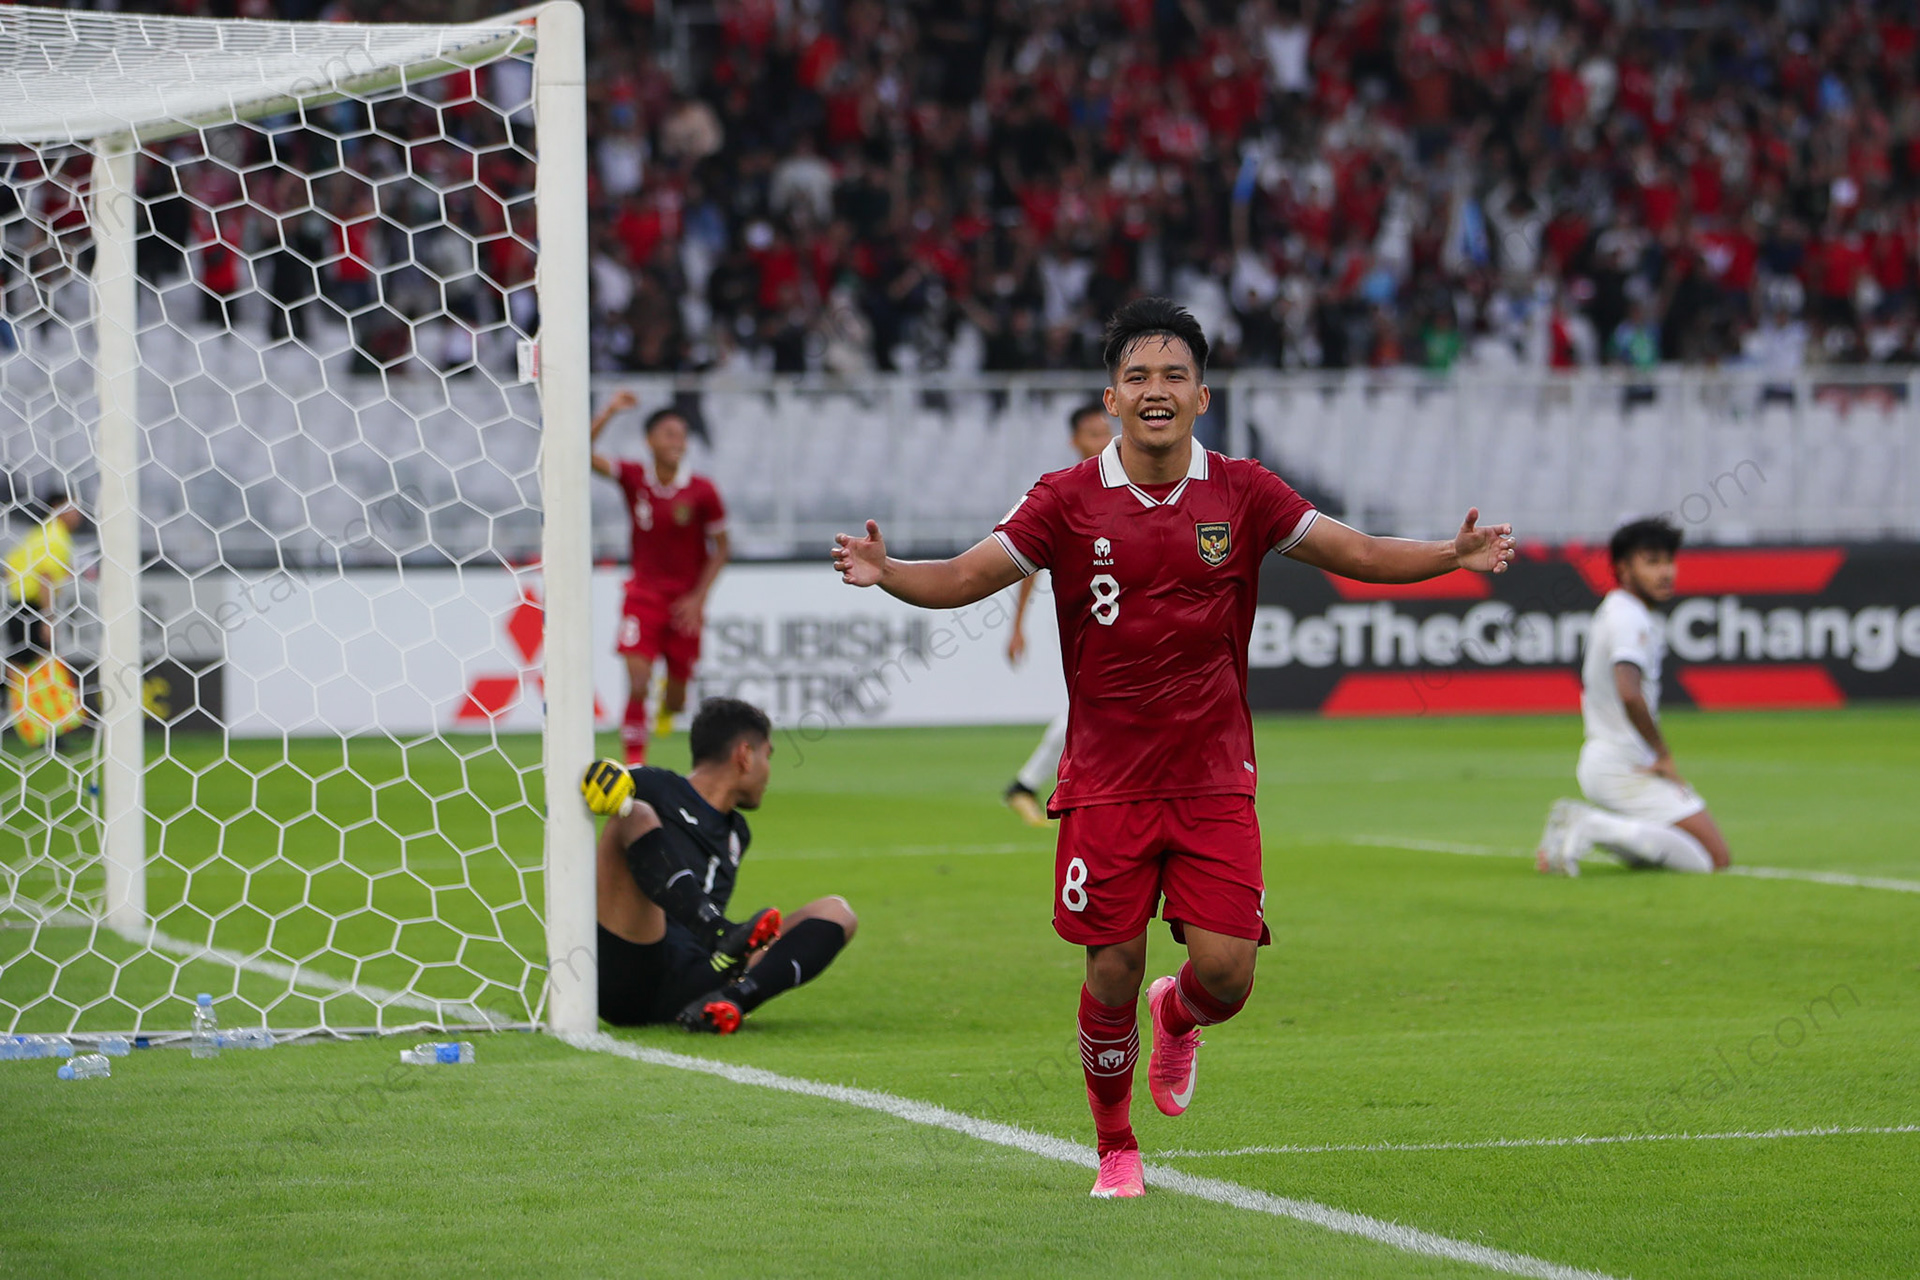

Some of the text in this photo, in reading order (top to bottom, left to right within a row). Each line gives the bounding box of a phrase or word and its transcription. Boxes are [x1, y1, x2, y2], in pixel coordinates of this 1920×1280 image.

[1093, 558, 1114, 566] MILLS
[1090, 574, 1120, 626] 8
[1062, 857, 1088, 912] 8
